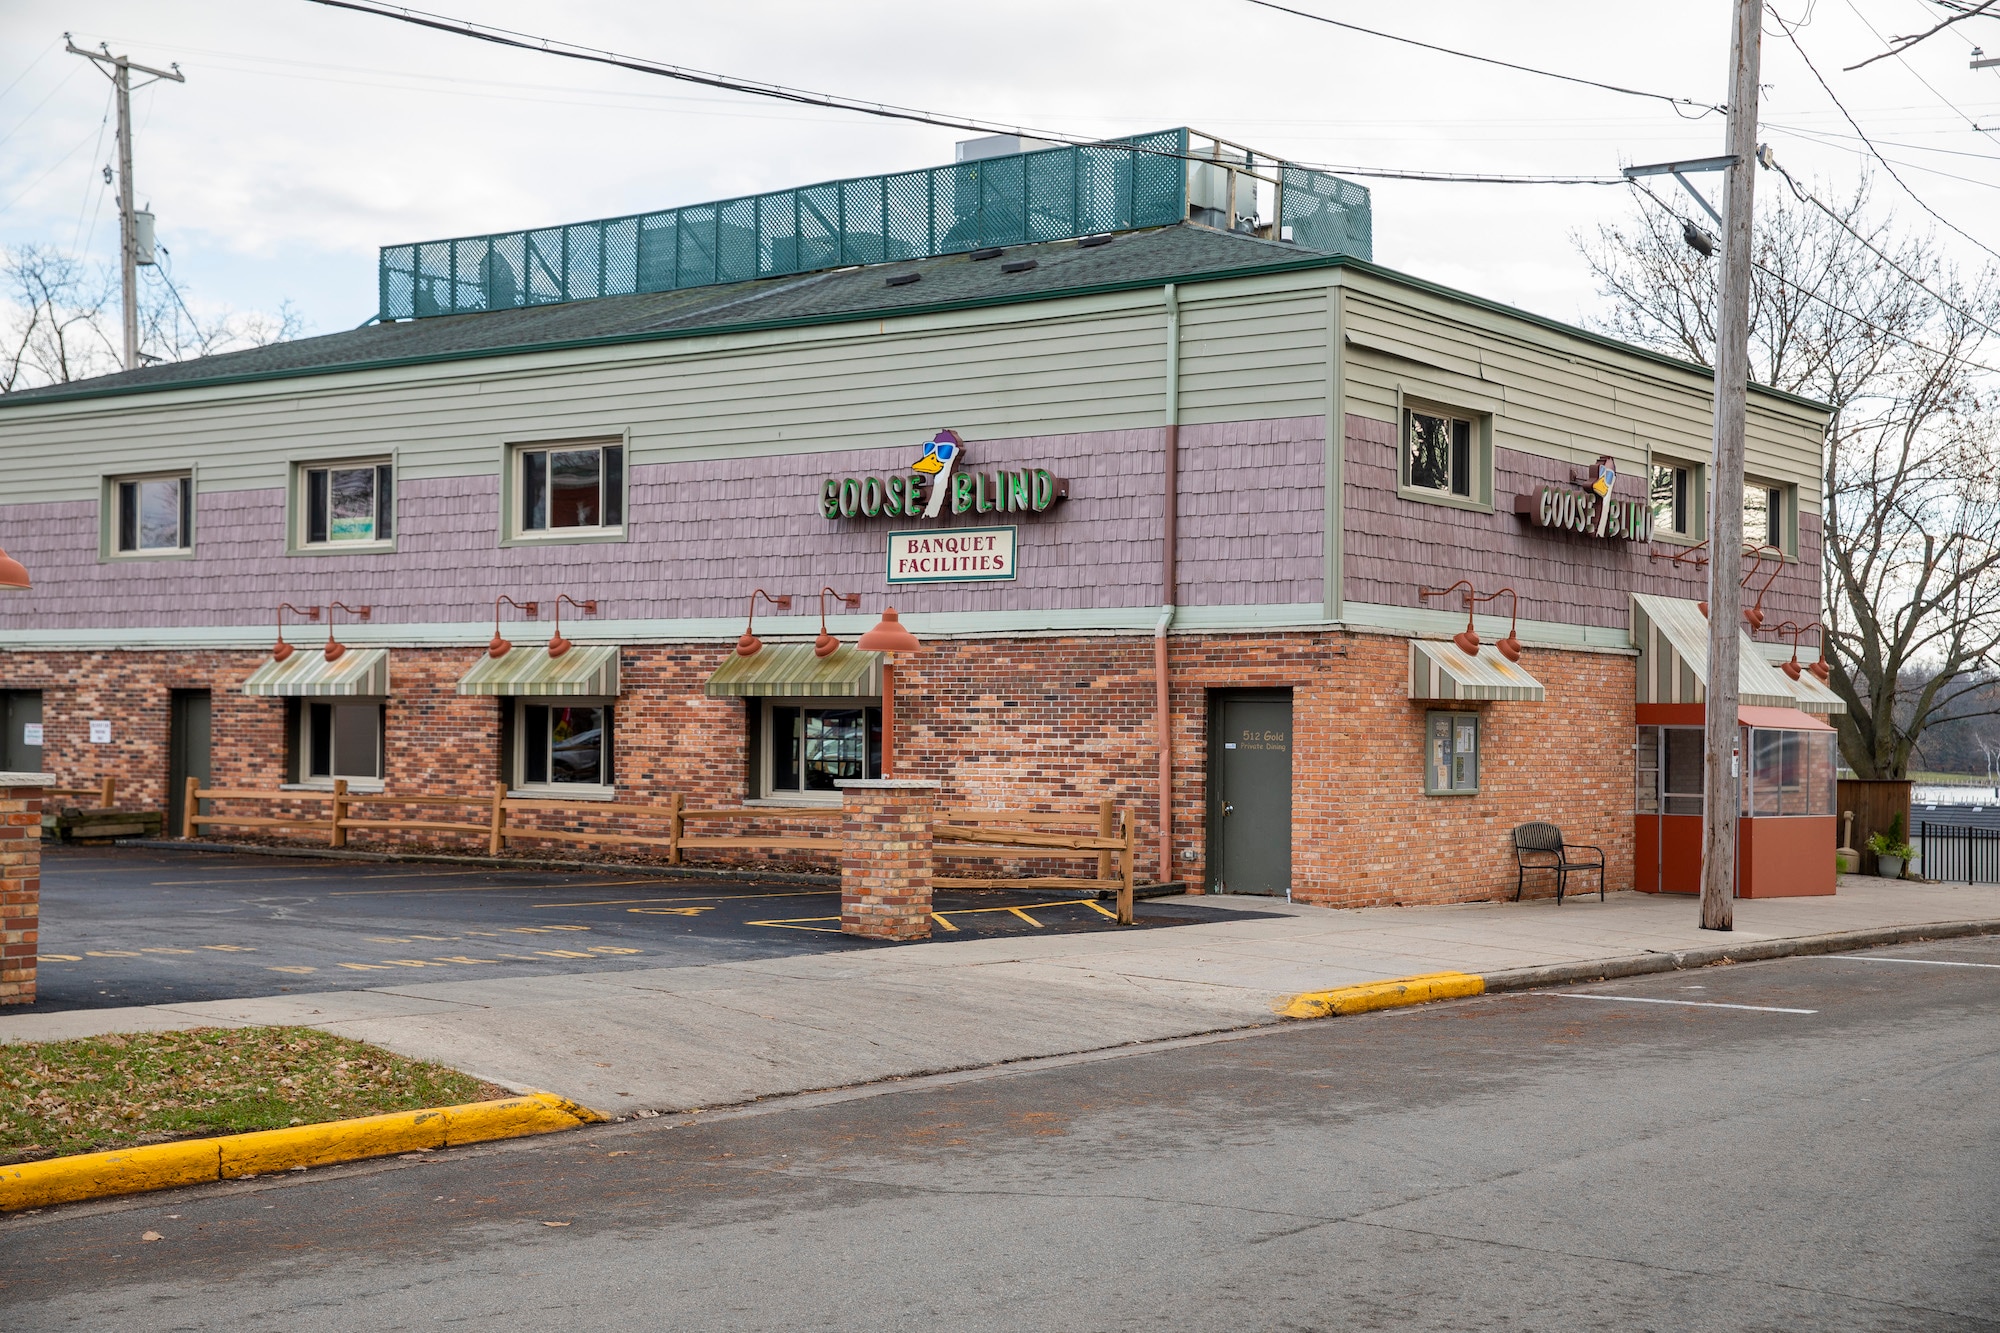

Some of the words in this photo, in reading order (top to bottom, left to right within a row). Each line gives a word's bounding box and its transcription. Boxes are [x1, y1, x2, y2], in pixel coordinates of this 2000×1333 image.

[818, 475, 926, 519] GOOSE
[952, 467, 1056, 515] BLIND
[1540, 485, 1596, 534] GOOSE
[1609, 499, 1654, 544] BLIND
[907, 536, 996, 554] BANQUET
[899, 555, 1004, 573] FACILITIES
[1242, 730, 1260, 741] 512
[1263, 730, 1284, 741] Gold
[1240, 743, 1264, 751] Private
[1266, 743, 1286, 752] Dining
[37, 944, 257, 962] OOSE
[266, 946, 644, 974] PARKING
